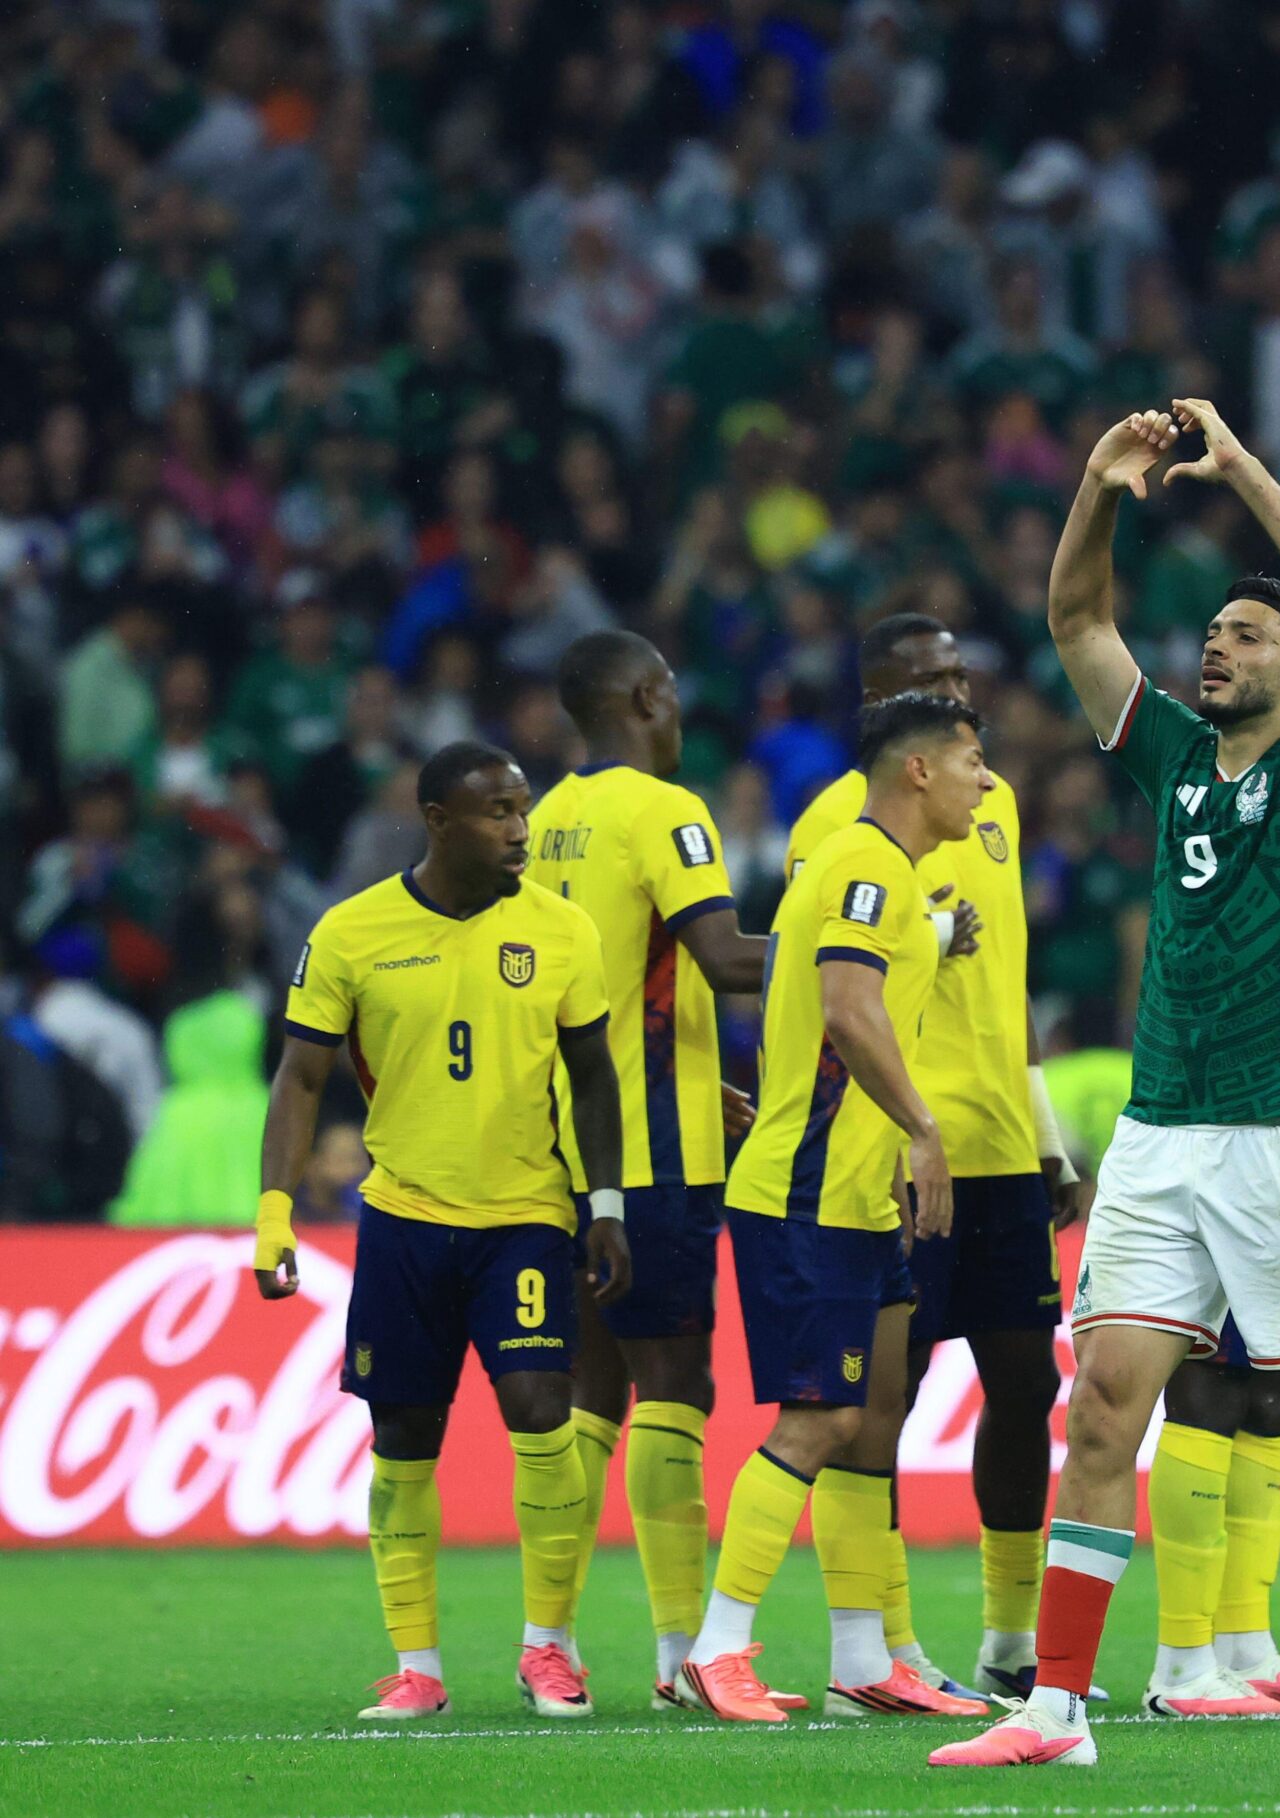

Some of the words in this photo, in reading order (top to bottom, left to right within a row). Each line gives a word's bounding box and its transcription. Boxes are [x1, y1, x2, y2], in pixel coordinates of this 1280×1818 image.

[1181, 834, 1218, 889] 9
[374, 954, 441, 971] marathon
[448, 1020, 473, 1082] 9
[515, 1268, 546, 1328] 9
[499, 1335, 564, 1351] marathon
